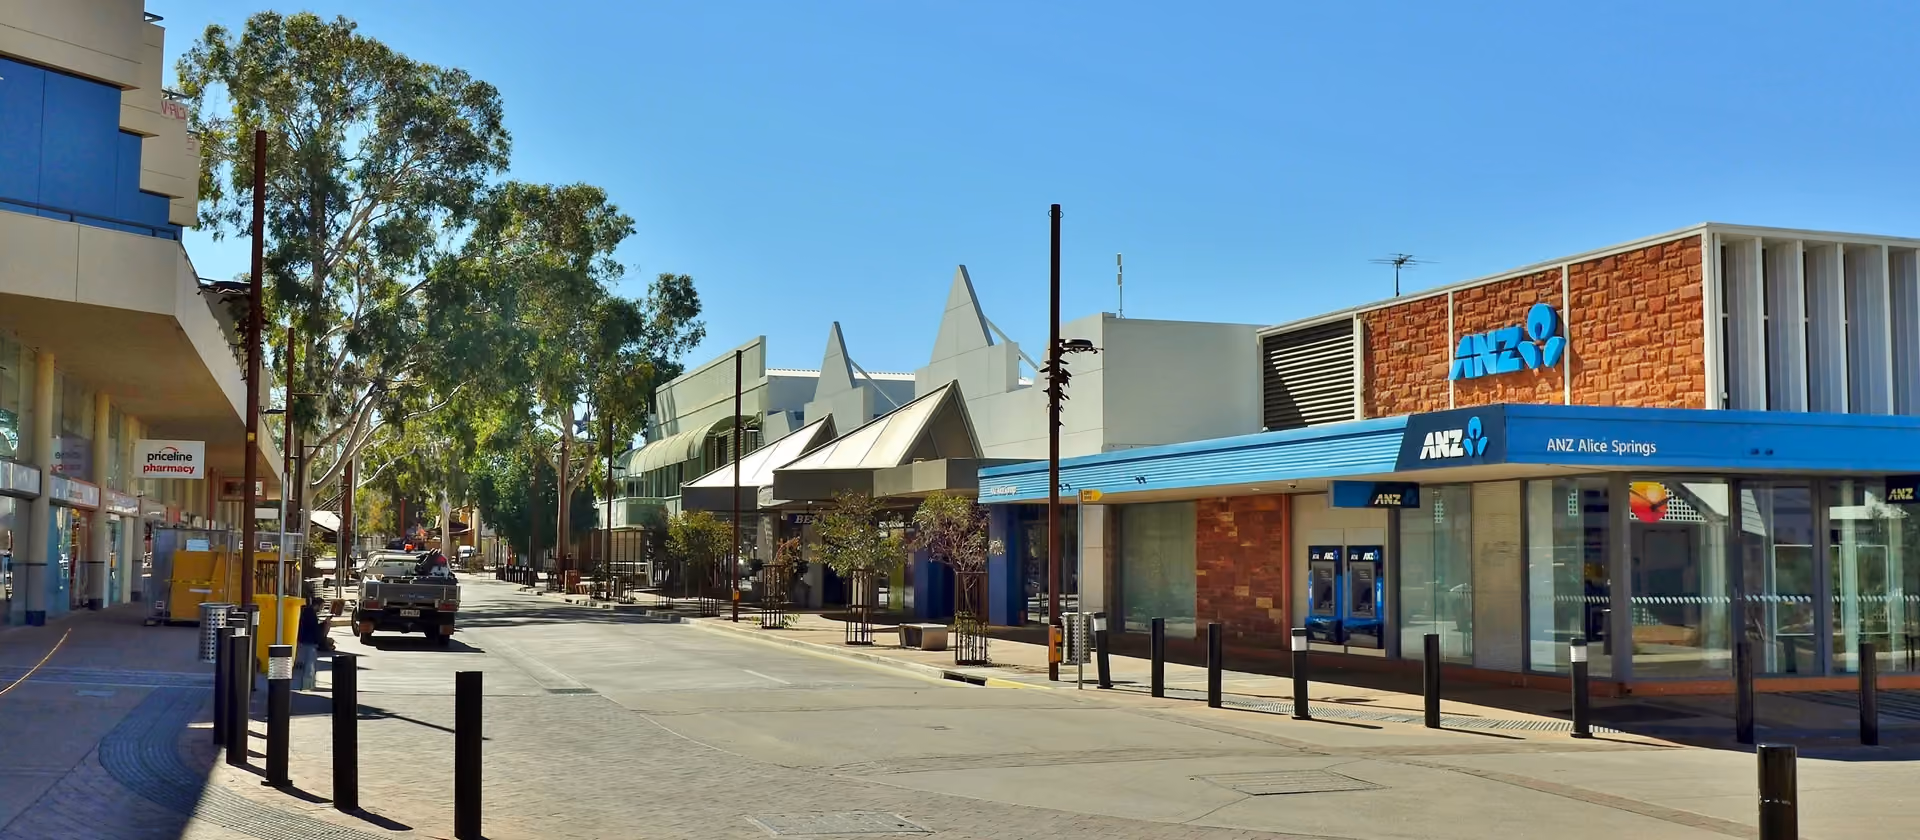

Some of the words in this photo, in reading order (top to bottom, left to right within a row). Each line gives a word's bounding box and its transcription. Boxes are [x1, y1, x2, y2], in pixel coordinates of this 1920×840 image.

[1448, 325, 1524, 380] ANZ
[1420, 429, 1464, 460] ANZ
[1546, 438, 1575, 452] ANZ
[1577, 438, 1608, 453] Alice
[1611, 439, 1657, 457] Springs
[146, 450, 193, 463] priceline
[143, 463, 195, 475] pharmacy
[1374, 493, 1402, 506] ANZ
[1888, 487, 1914, 501] ANZ
